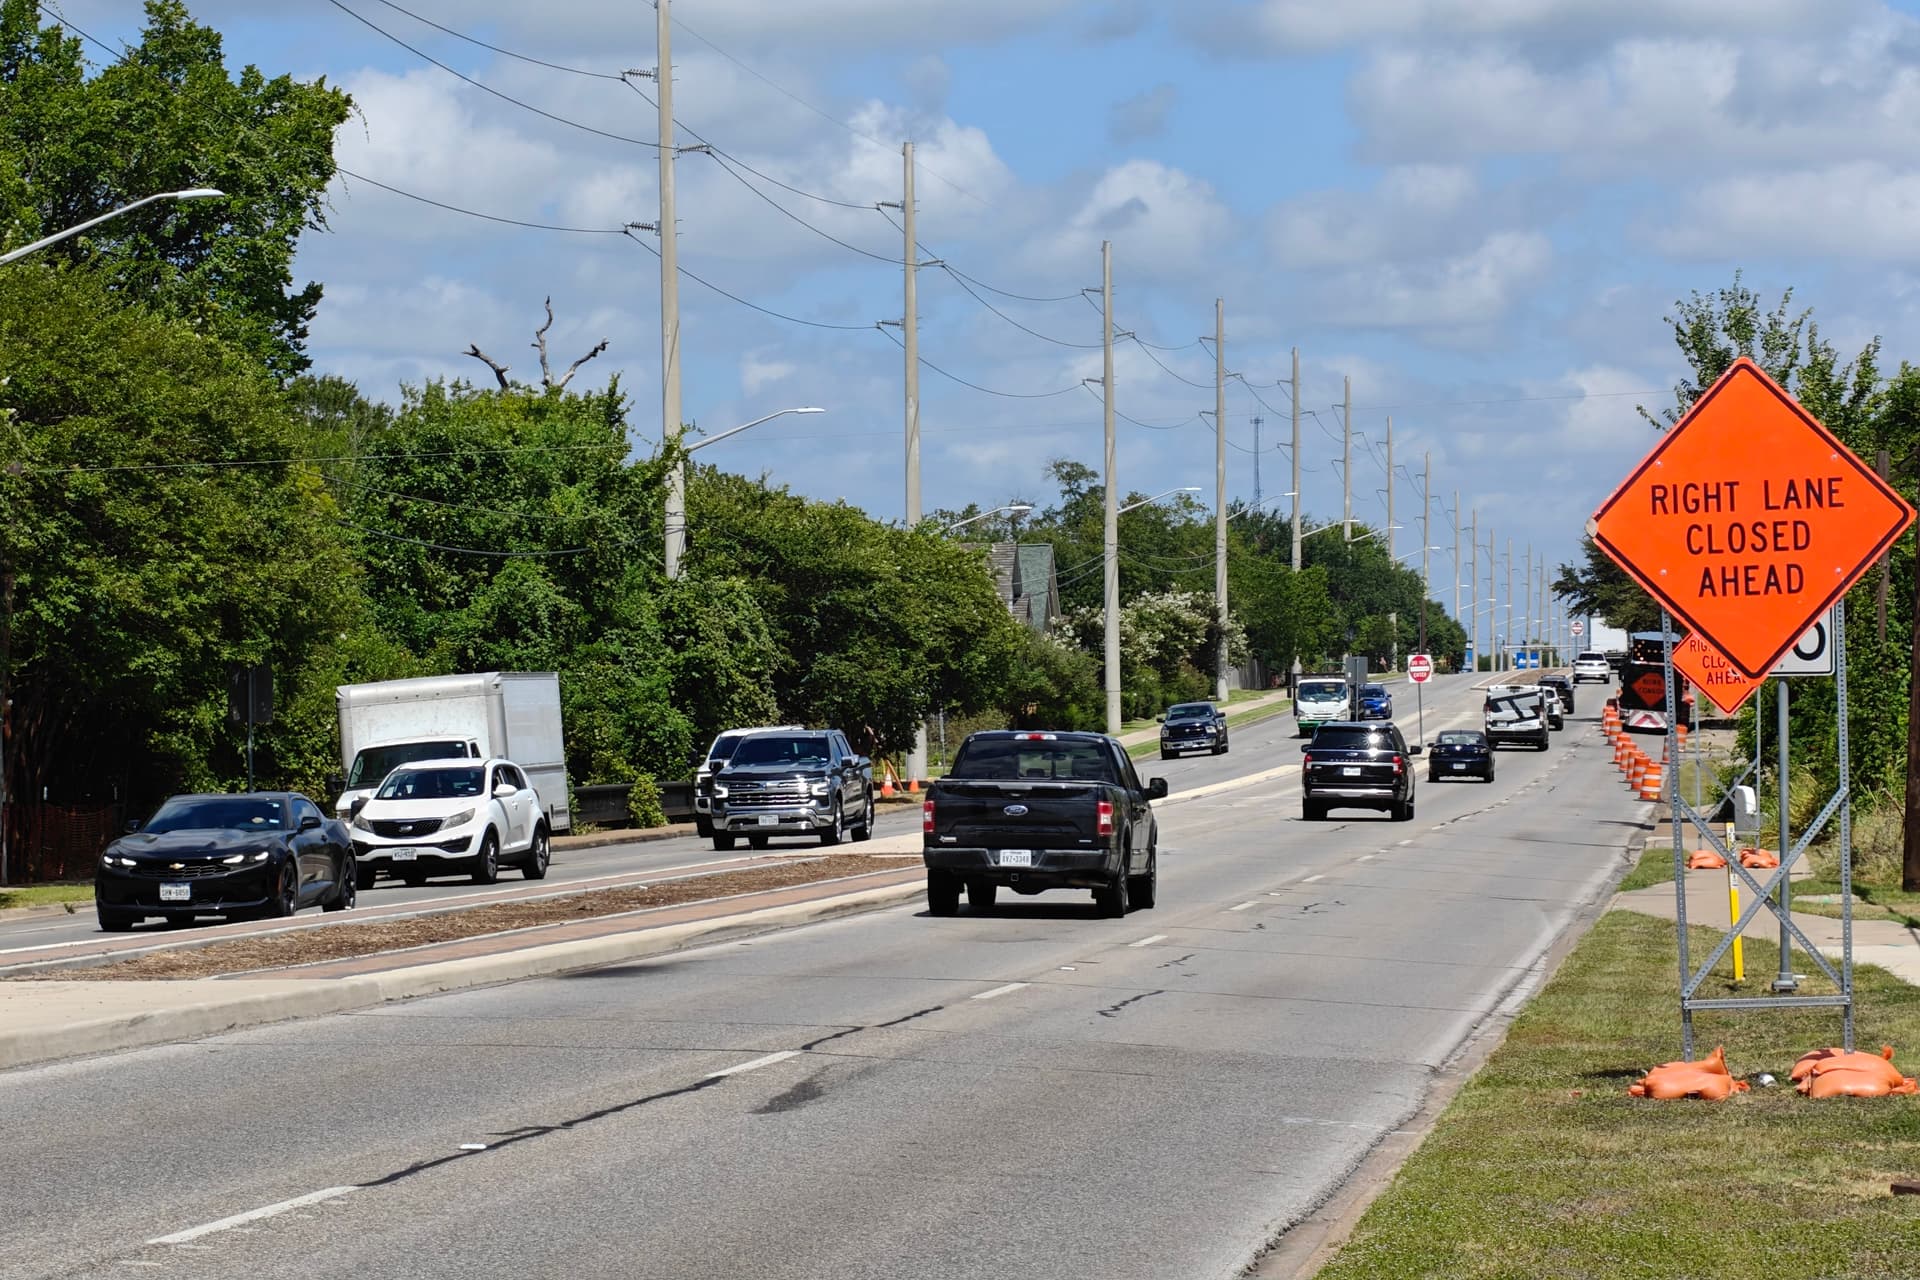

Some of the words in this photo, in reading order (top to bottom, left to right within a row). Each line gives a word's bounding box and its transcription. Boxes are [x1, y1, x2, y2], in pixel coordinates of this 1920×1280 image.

[1651, 481, 1740, 515] RIGHT
[1763, 477, 1845, 511] LANE
[1686, 520, 1811, 556] CLOSED
[1698, 564, 1805, 598] AHEAD
[1690, 640, 1711, 653] RIG
[1702, 655, 1729, 669] CLO
[1706, 671, 1747, 685] AHEA
